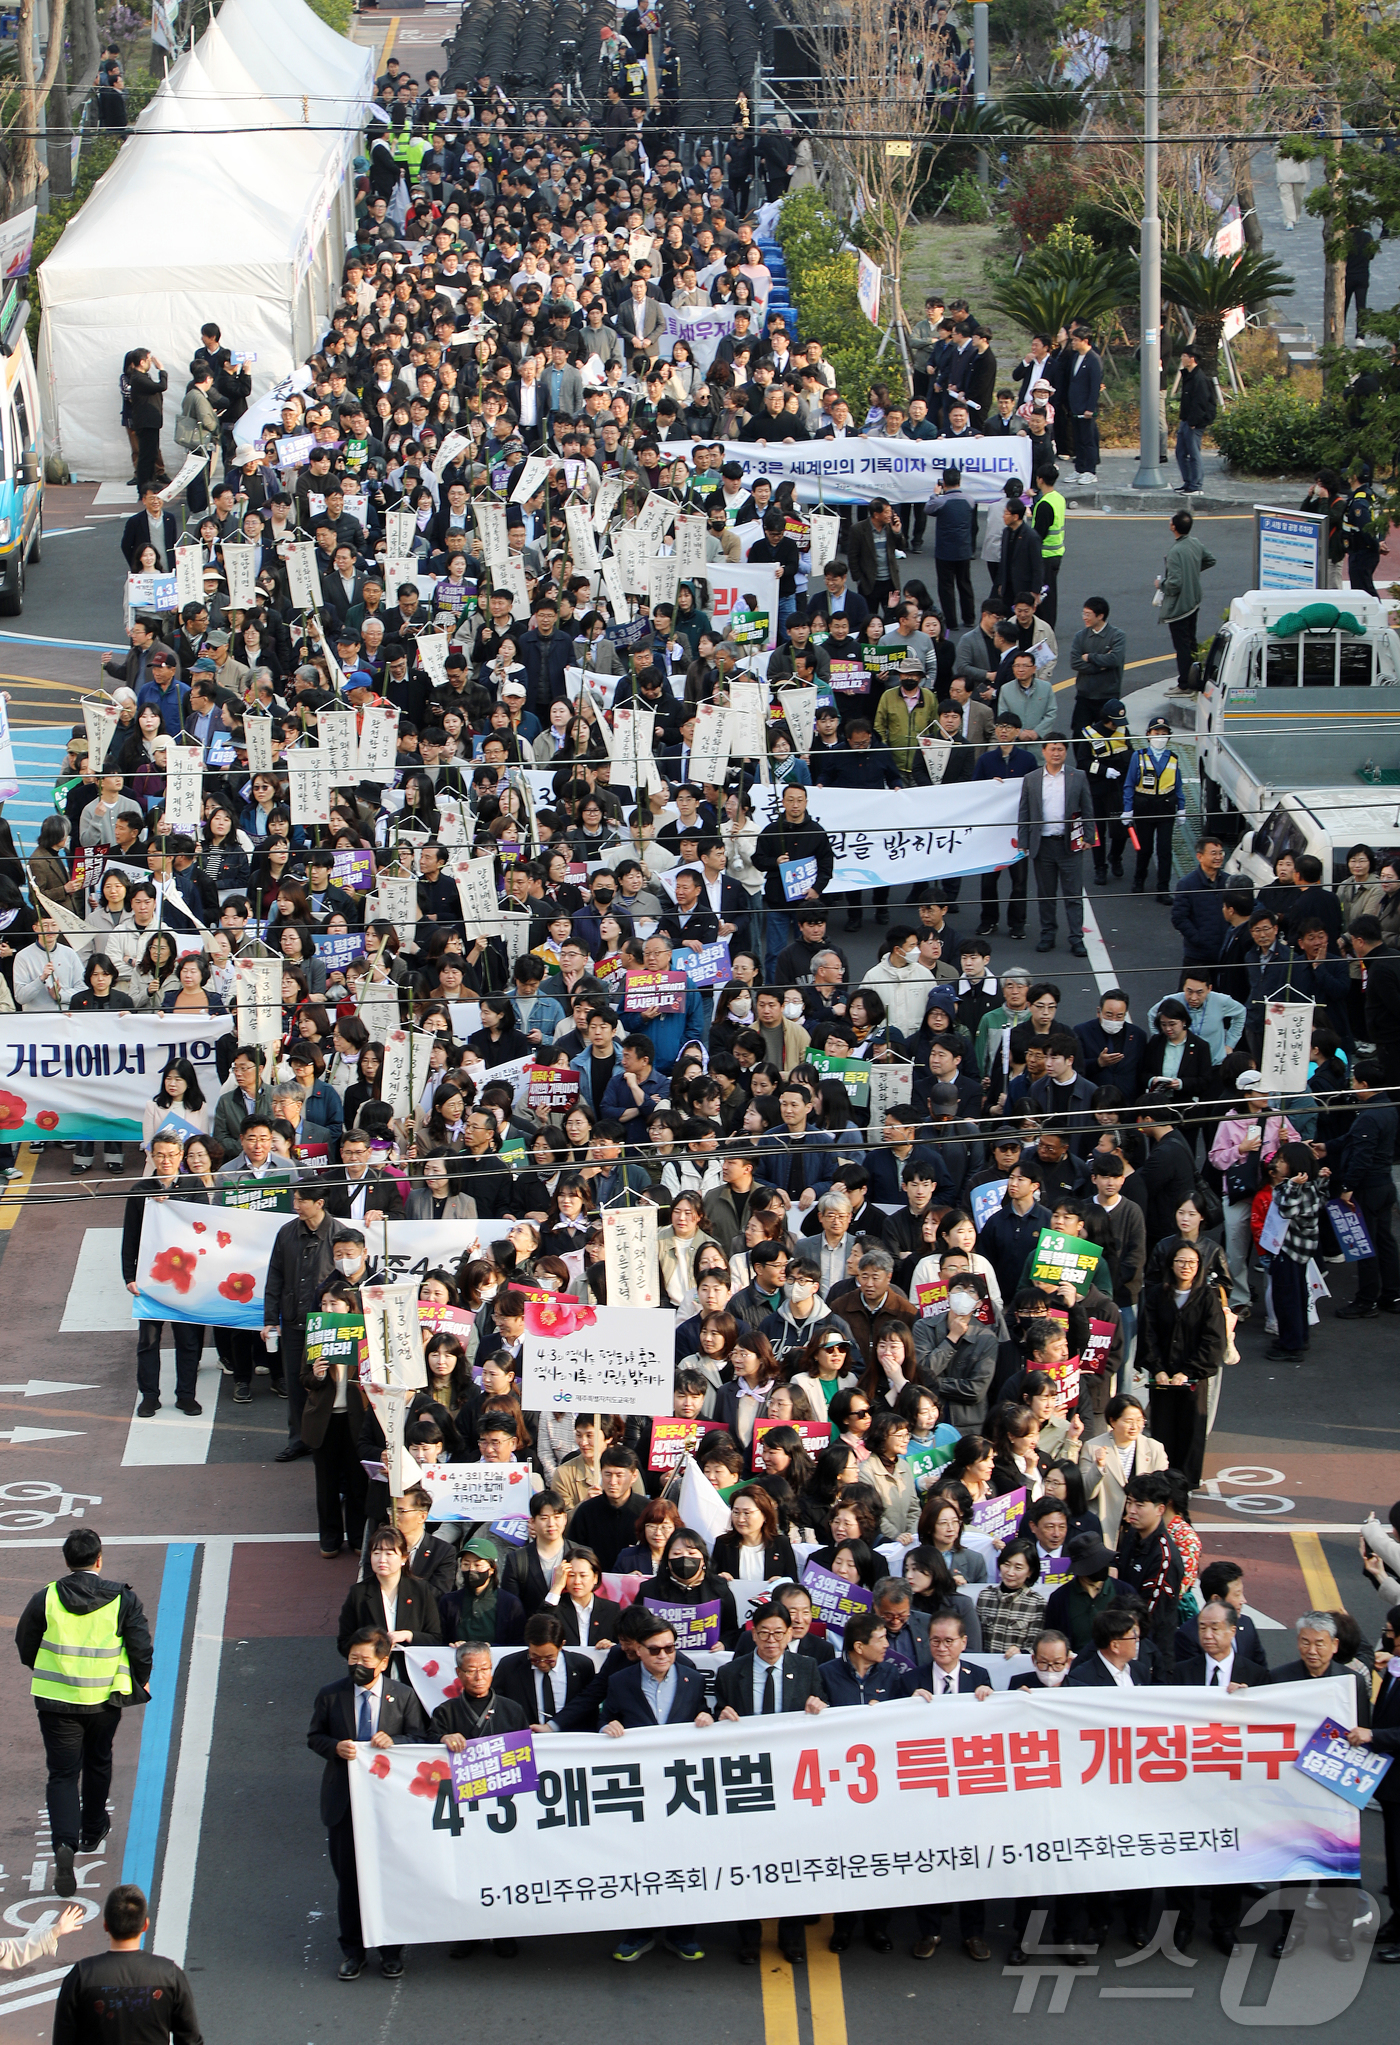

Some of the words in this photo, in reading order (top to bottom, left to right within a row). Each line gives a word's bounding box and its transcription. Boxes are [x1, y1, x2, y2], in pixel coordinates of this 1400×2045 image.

[790, 459, 854, 477] 세계인의
[860, 457, 927, 473] 기록이자
[156, 585, 173, 596] 4·3
[157, 596, 178, 610] 대행
[609, 628, 626, 639] 4·3
[864, 647, 876, 655] 4·3
[830, 662, 858, 673] 주4·3은
[210, 751, 236, 763] 대행
[829, 832, 875, 860] 권을
[351, 859, 369, 872] 즉각
[785, 865, 804, 883] 4·3
[330, 872, 363, 888] 정하라!
[333, 935, 362, 953] 평화
[676, 954, 697, 971] 4·3
[697, 943, 726, 963] 평화
[262, 968, 271, 991] 4·3
[628, 974, 668, 987] 제주4·3은
[246, 983, 258, 1030] 정신계승
[1290, 1016, 1305, 1066] 양담배를
[6, 1043, 145, 1078] 거리에서
[1272, 1028, 1288, 1075] 피지말자
[813, 1060, 829, 1072] 4·3
[388, 1057, 404, 1105] 정신계승
[531, 1070, 562, 1082] 제주4·3은
[844, 1070, 870, 1083] 즉각
[225, 1190, 261, 1207] 특별법
[975, 1190, 998, 1211] 4·3
[615, 1225, 627, 1237] 또
[632, 1215, 646, 1242] 역사
[1040, 1235, 1065, 1251] 4·3
[1037, 1249, 1079, 1267] 특별법
[1078, 1255, 1099, 1271] 즉각
[632, 1249, 647, 1290] 왜곡은
[1033, 1264, 1087, 1284] 개정하라!
[395, 1296, 405, 1327] 4·3
[418, 1306, 454, 1321] 주4·3은
[308, 1316, 322, 1331] 4·3
[436, 1321, 471, 1337] 기록이자
[307, 1329, 335, 1346] 특별법
[336, 1326, 365, 1341] 즉각
[307, 1340, 352, 1358] 개정하라!
[396, 1332, 412, 1360] 항쟁
[565, 1348, 595, 1365] 역사는
[628, 1368, 665, 1387] 밝히다
[1049, 1366, 1073, 1379] 4·3은
[575, 1394, 636, 1404] 제주특별자치도교육청
[654, 1425, 706, 1439] 제주4·3은
[912, 1455, 933, 1473] 4·3
[484, 1471, 507, 1481] 진실,
[452, 1482, 482, 1492] 우리가
[484, 1482, 504, 1492] 함께
[452, 1493, 504, 1504] 지켜갑니다
[974, 1495, 1011, 1524] 4·3왜곡
[1006, 1506, 1025, 1520] 즉각
[496, 1521, 529, 1541] 대행
[992, 1521, 1018, 1539] 하라!
[803, 1569, 850, 1597] 4·3왜곡
[837, 1600, 868, 1615] 즉각
[689, 1616, 718, 1632] 즉각
[676, 1633, 707, 1650] 하라!
[453, 1736, 506, 1765] 4·3왜곡
[1326, 1736, 1388, 1775] 대행진
[455, 1756, 500, 1784] 처벌법
[501, 1745, 532, 1768] 즉각
[1302, 1749, 1345, 1782] 평화
[432, 1778, 518, 1838] 4·3
[536, 1763, 646, 1832] 왜곡
[663, 1752, 776, 1819] 처벌
[792, 1743, 879, 1807] 4·3
[896, 1729, 1062, 1798] 특별법
[1079, 1722, 1300, 1785] 개정촉구
[457, 1766, 522, 1801] 제정하라!
[1340, 1767, 1375, 1793] 4·3
[480, 1866, 708, 1908] 5·18민주유공자유족회
[730, 1845, 979, 1887] 5·18민주화운동부상자회
[1002, 1827, 1240, 1865] 5·18민주화운동공로자회
